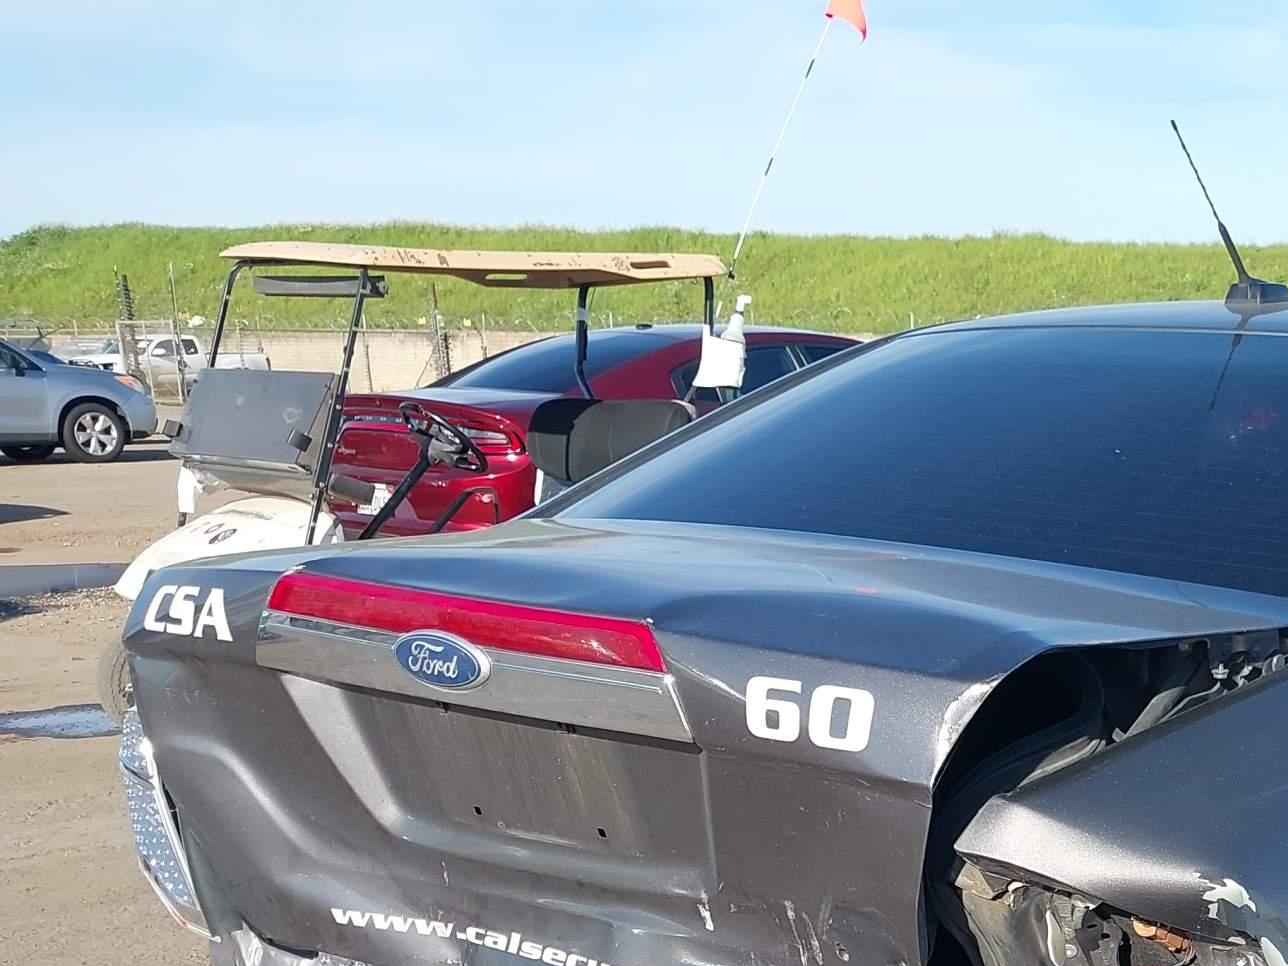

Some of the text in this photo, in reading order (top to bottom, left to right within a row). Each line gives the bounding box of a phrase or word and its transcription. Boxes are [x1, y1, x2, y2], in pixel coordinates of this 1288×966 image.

[143, 584, 234, 642] CSA
[408, 640, 458, 679] Ford
[744, 675, 875, 752] 60
